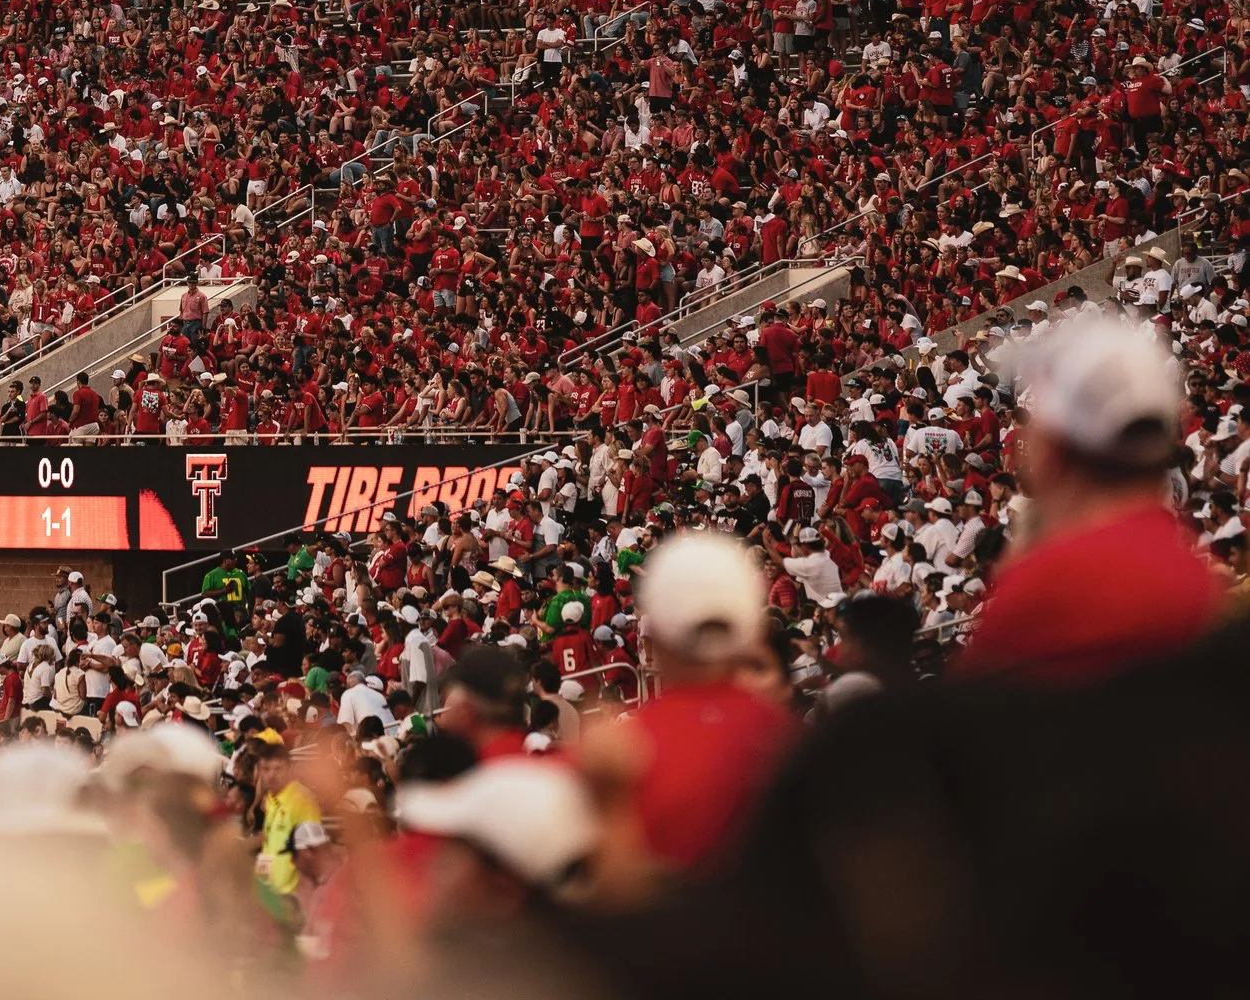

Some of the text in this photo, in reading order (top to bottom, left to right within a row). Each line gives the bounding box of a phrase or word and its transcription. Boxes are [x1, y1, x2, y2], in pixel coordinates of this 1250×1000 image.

[38, 457, 74, 488] 0-0
[302, 467, 404, 532] TIRE
[41, 507, 71, 537] 1-1
[562, 648, 577, 671] 6
